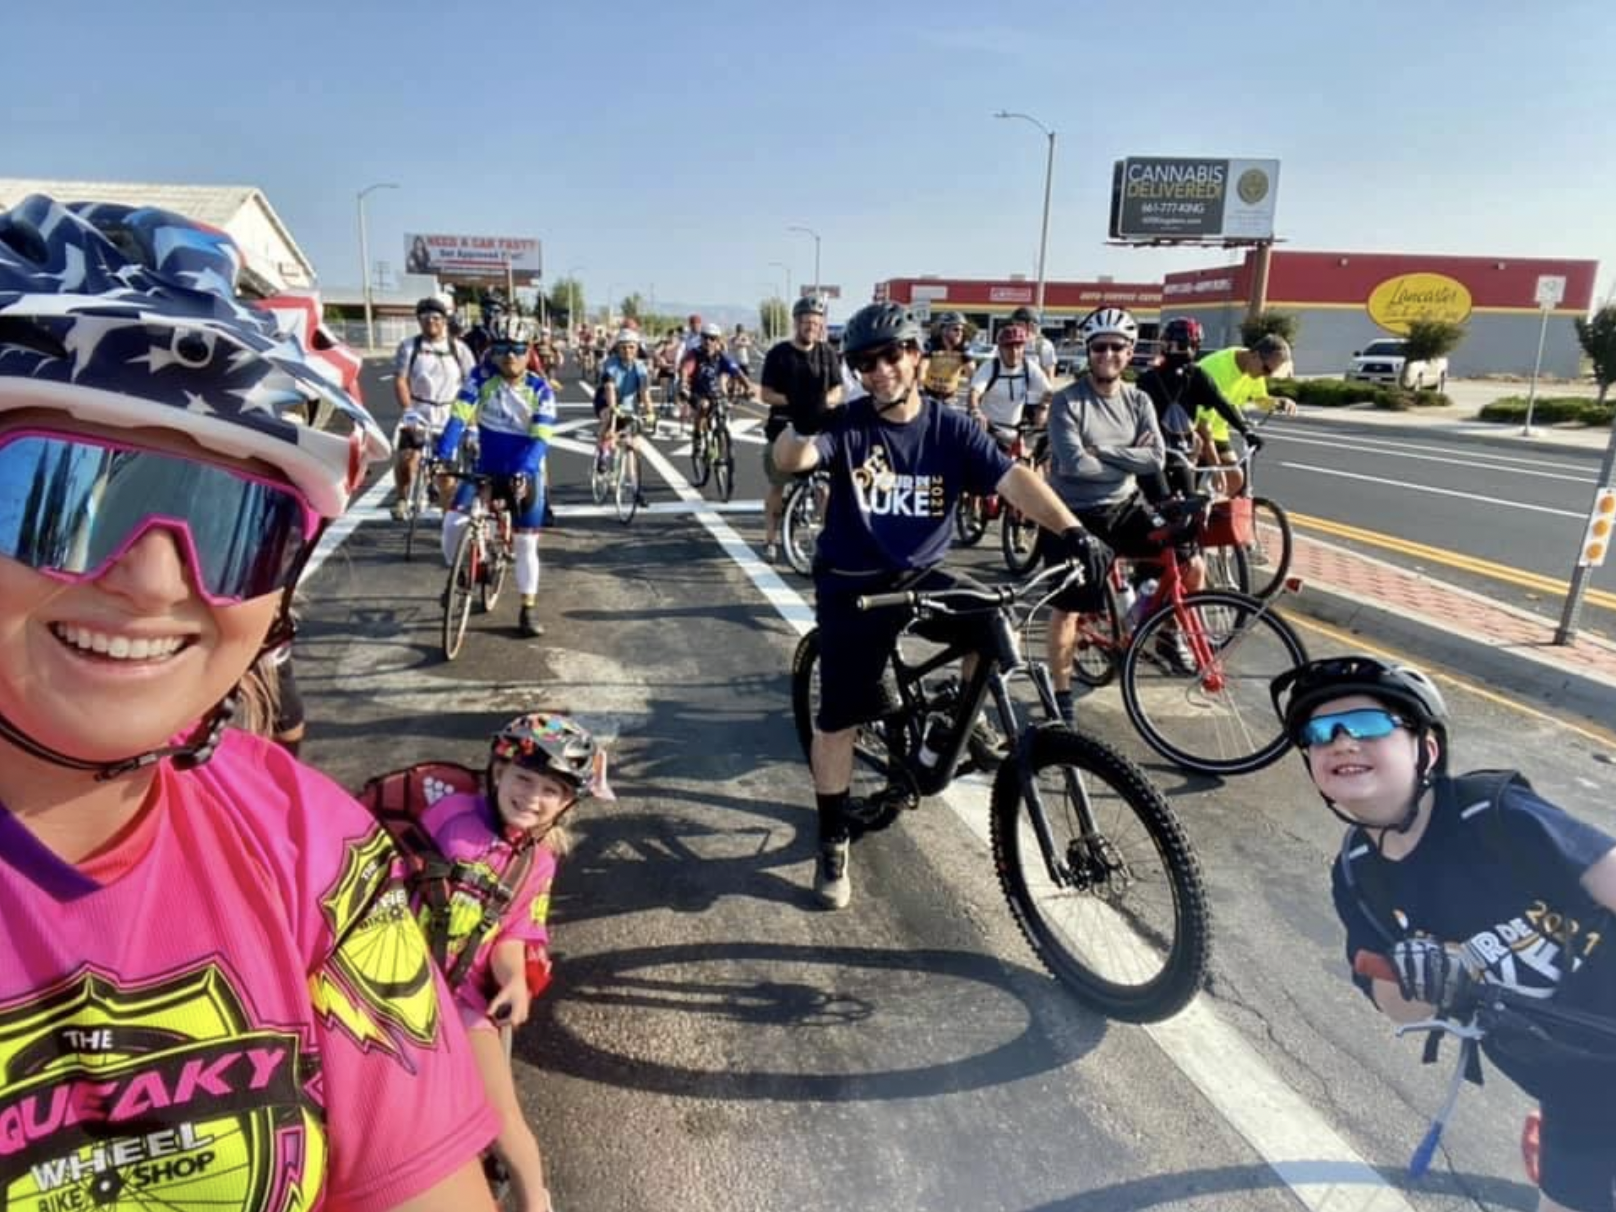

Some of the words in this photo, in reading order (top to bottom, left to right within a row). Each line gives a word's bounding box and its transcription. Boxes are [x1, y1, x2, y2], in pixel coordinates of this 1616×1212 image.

[1128, 164, 1223, 183] CANNABIS
[1127, 182, 1223, 199] DELIVERED!
[1389, 280, 1457, 305] Lancaster
[855, 481, 930, 515] LUKE
[63, 1028, 114, 1050] THE
[31, 1121, 216, 1192] WHEEL
[38, 1187, 83, 1212] BIKE
[133, 1150, 216, 1188] SHOP
